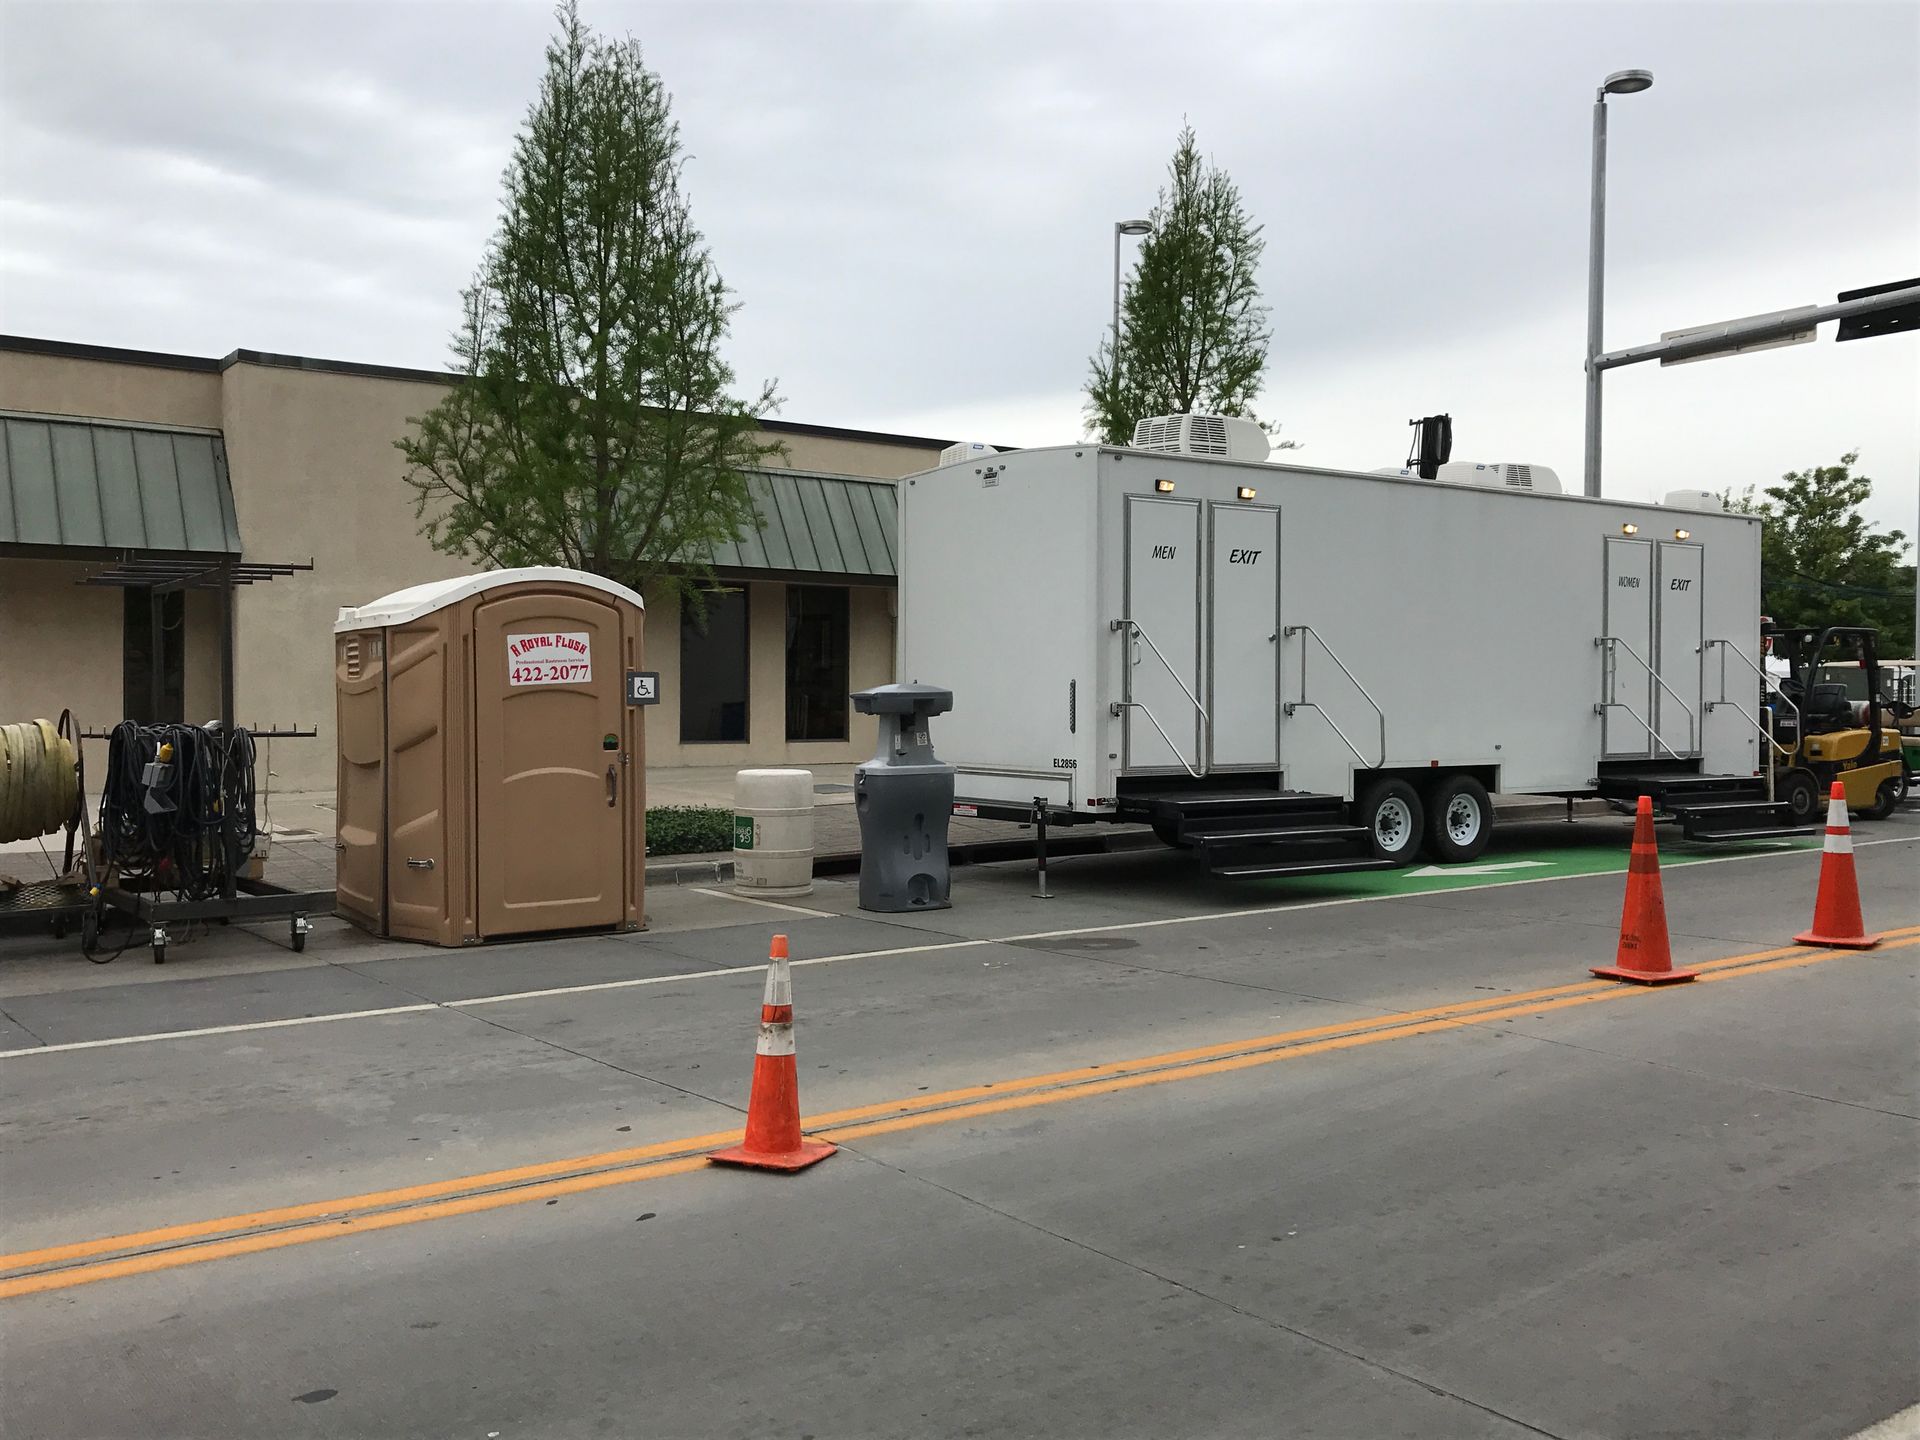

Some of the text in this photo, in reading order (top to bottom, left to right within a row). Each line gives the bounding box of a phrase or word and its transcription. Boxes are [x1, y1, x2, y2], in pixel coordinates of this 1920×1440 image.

[1151, 545, 1176, 560] MEN
[1229, 549, 1262, 565] EXIT
[1618, 576, 1640, 588] WOMEN
[1670, 578, 1692, 591] EXIT
[510, 644, 521, 657] A
[512, 665, 589, 682] 422-2077
[1053, 758, 1077, 769] EL2856
